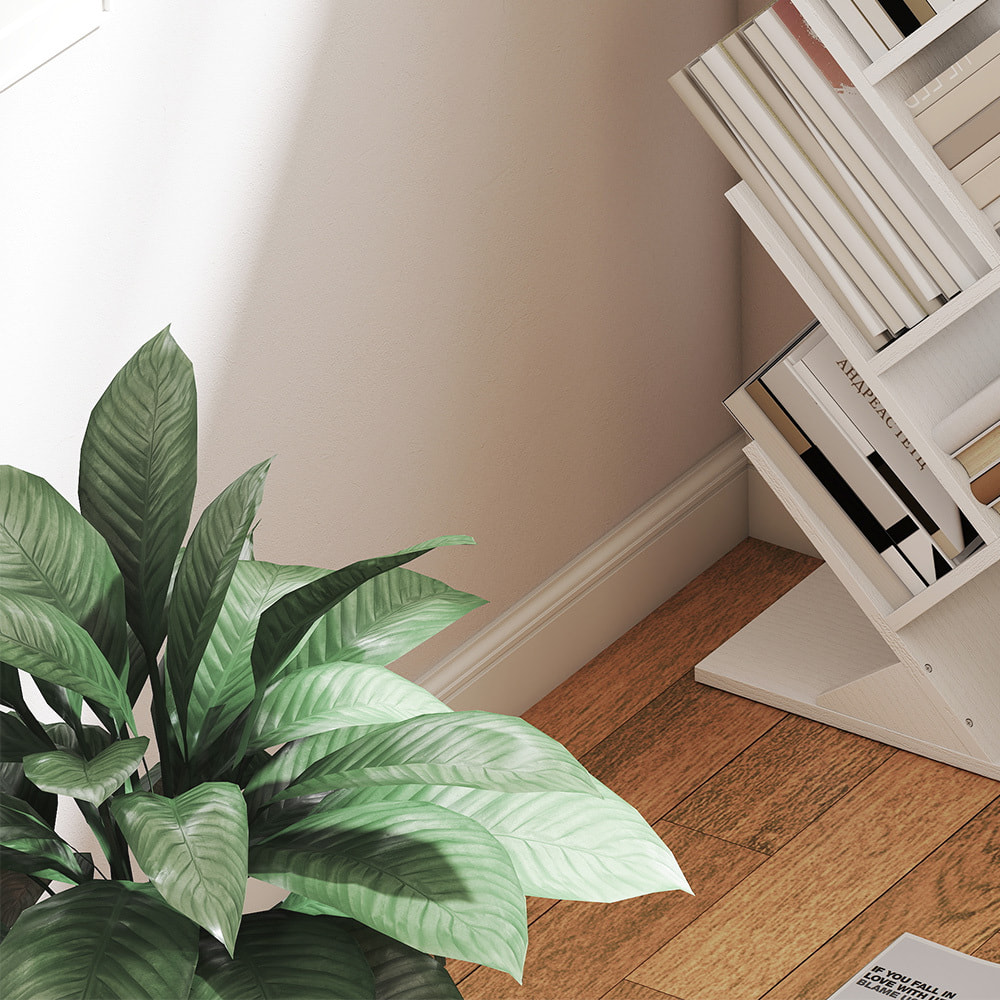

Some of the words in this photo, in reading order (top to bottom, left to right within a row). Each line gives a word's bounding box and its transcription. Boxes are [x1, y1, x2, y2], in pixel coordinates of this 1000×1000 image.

[856, 978, 901, 999] BLAME
[863, 972, 897, 988] LOVE
[897, 984, 929, 1000] WITH
[871, 965, 886, 974] IF
[886, 970, 912, 984] YOU
[911, 980, 939, 995] FALL
[941, 990, 957, 1000] IN
